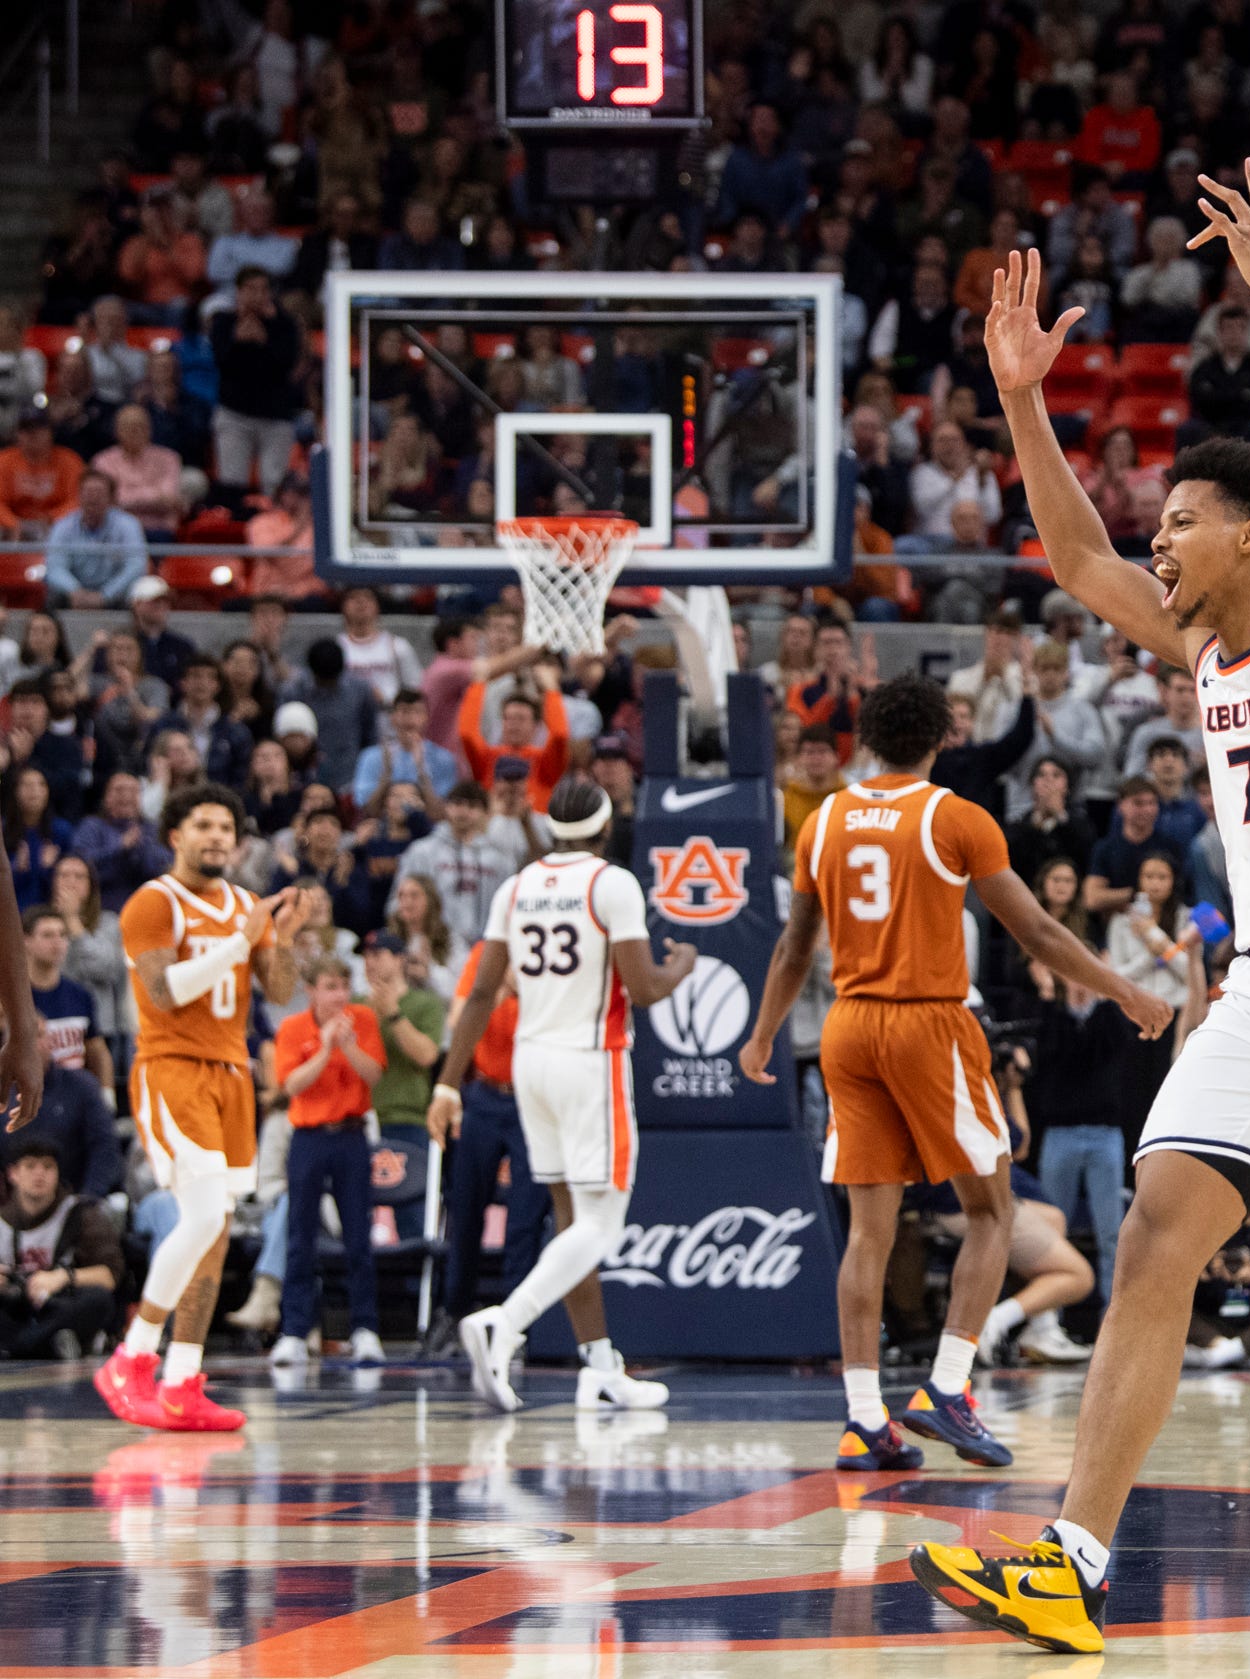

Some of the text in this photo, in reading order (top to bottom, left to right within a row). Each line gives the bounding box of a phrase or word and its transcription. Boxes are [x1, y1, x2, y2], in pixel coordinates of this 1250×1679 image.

[576, 4, 664, 105] 13
[845, 808, 902, 832] SWAIN
[846, 844, 891, 922] 3
[521, 924, 579, 977] 33
[653, 1074, 735, 1098] CREEK
[662, 1057, 733, 1078] WIND
